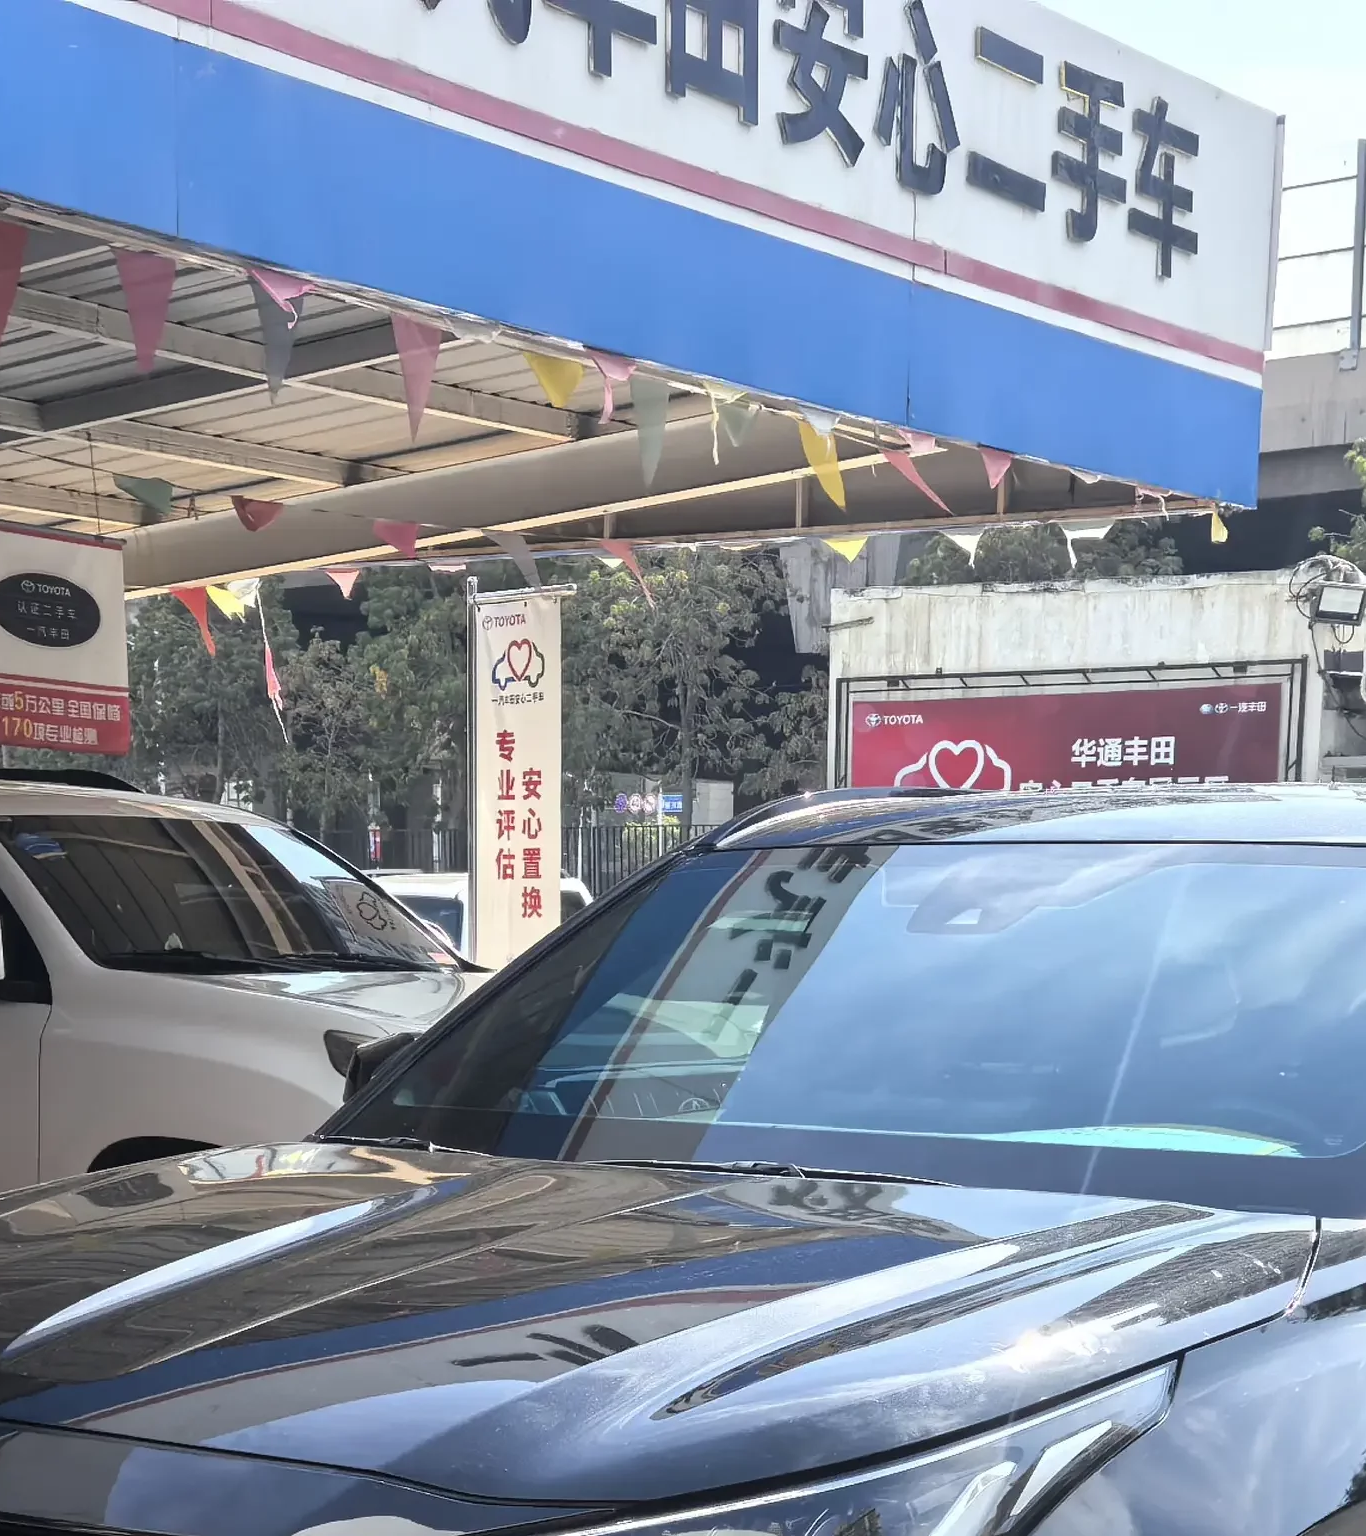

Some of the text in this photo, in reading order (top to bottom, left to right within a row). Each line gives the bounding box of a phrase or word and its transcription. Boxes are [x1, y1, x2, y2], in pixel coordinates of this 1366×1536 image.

[419, 0, 1199, 278] 田安心二手车
[38, 583, 71, 597] TOYOTA
[494, 614, 526, 628] TOYOTA
[2, 716, 98, 745] 170项专业检测
[883, 713, 924, 726] TOYOTA
[1070, 736, 1175, 768] 华通丰田
[495, 730, 517, 881] 专业评估
[521, 767, 543, 919] 安心置换
